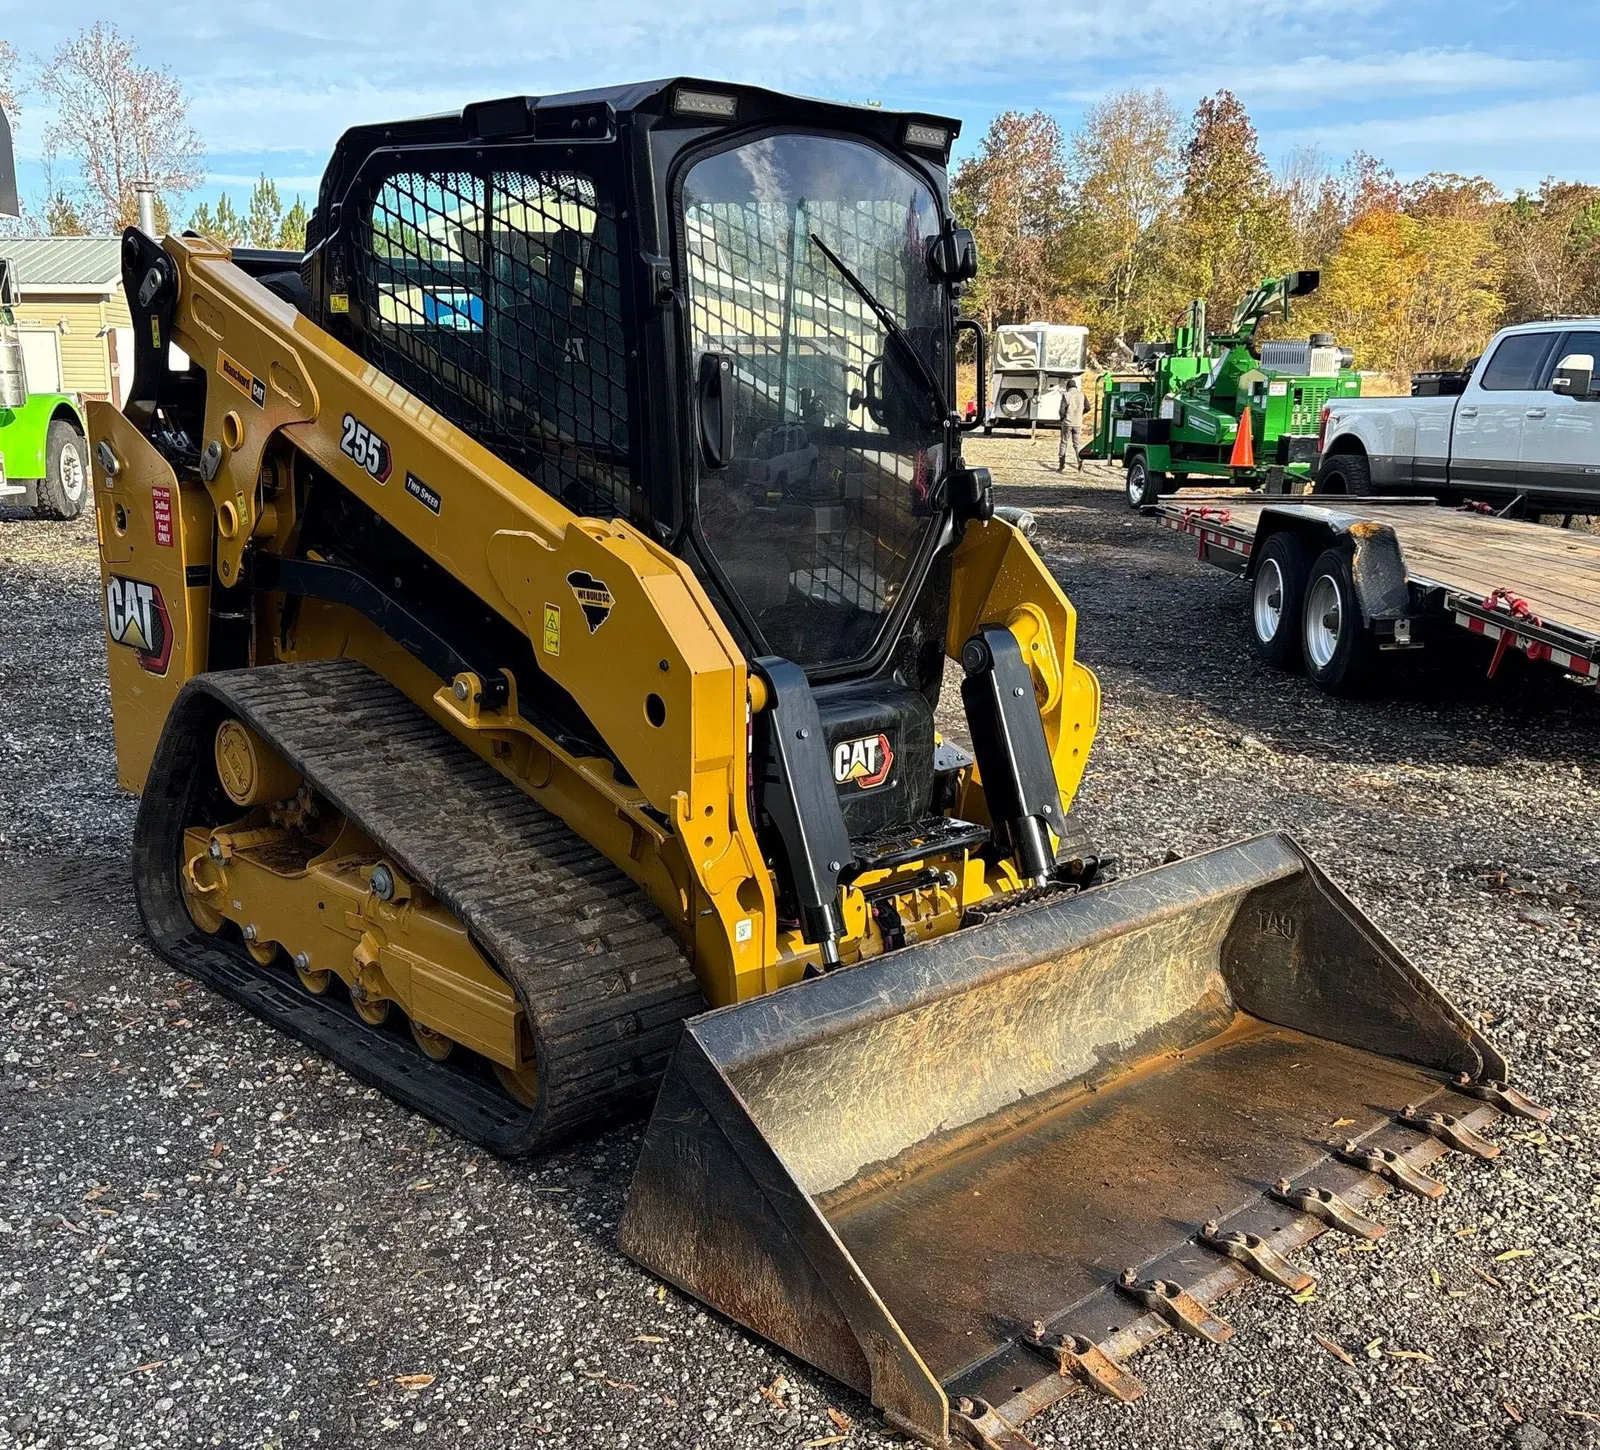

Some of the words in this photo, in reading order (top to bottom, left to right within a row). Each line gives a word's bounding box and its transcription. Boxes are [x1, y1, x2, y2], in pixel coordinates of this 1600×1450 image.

[223, 359, 251, 391] Blanchard
[252, 383, 264, 401] CAT
[340, 415, 382, 474] 255
[155, 510, 170, 521] Diesel
[158, 521, 169, 532] Fuel
[157, 532, 171, 543] ONLY
[577, 589, 586, 599] WE
[586, 590, 602, 602] BUILD
[602, 592, 610, 603] SC
[107, 576, 153, 651] CAT
[835, 737, 879, 781] CAT
